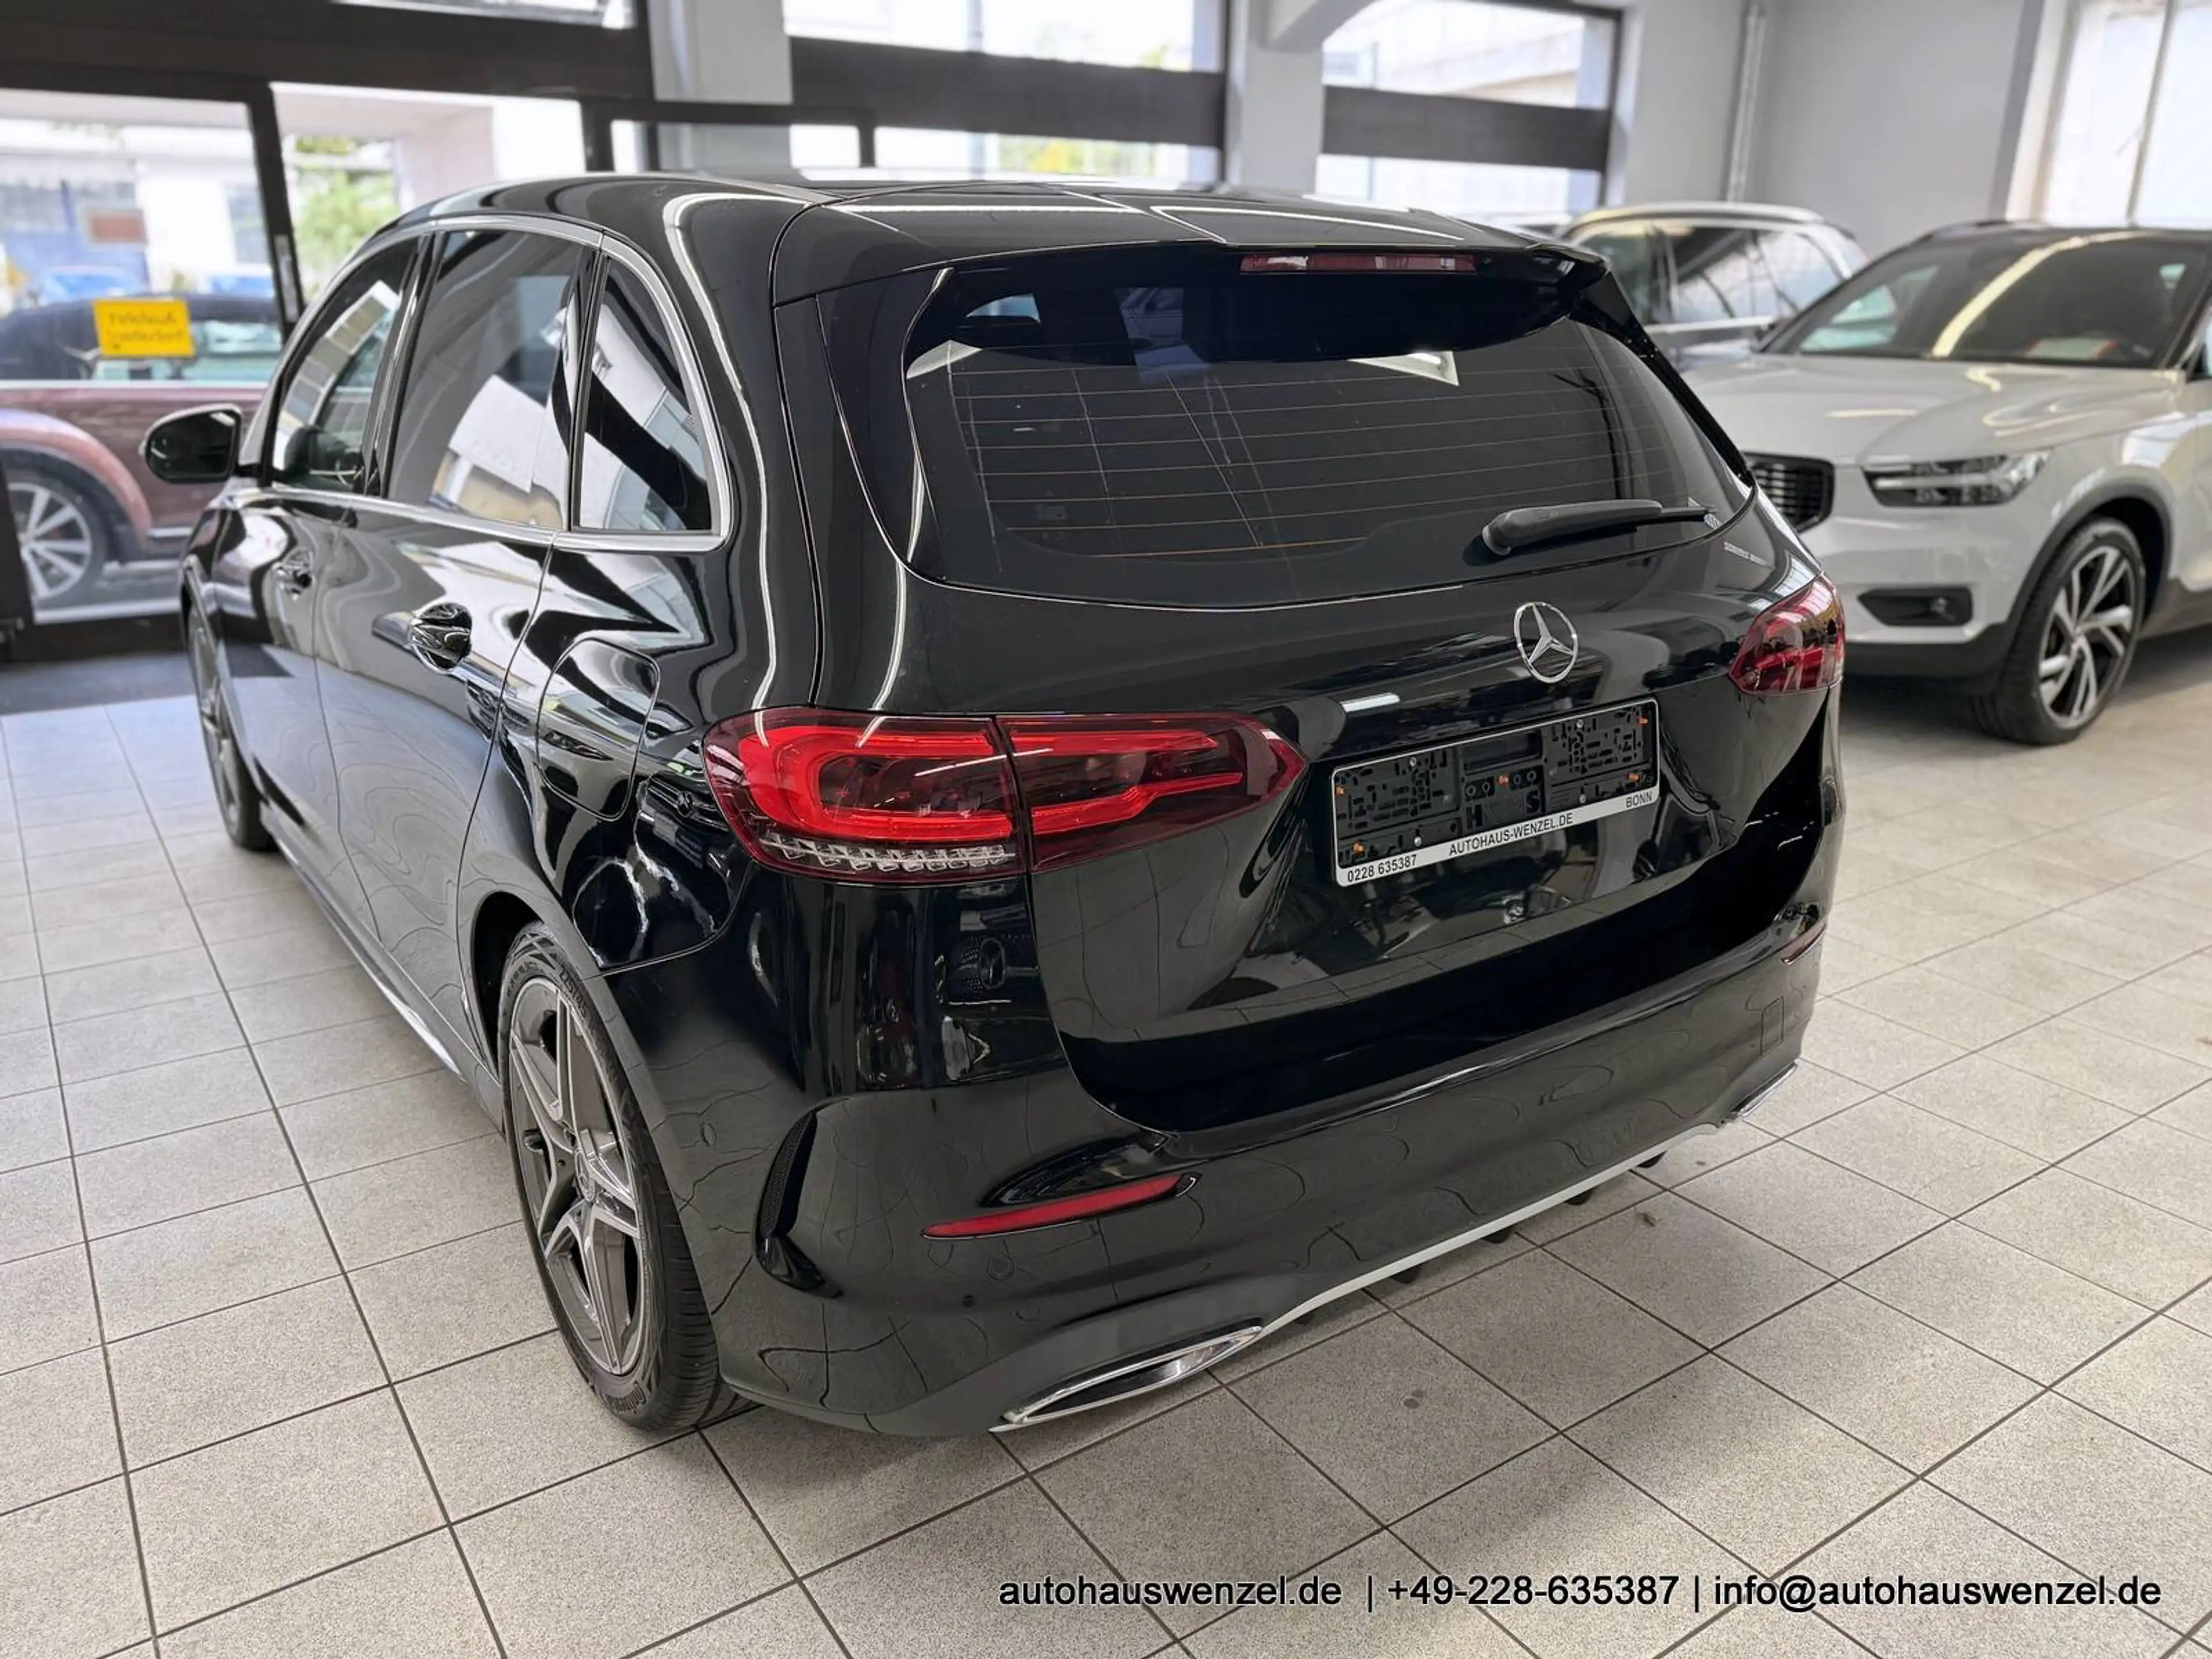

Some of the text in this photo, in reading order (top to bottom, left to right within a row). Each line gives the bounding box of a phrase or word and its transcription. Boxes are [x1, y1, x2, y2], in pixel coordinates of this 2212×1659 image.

[1347, 867, 1374, 882] 0228
[1378, 854, 1417, 875] 635387
[1449, 812, 1574, 856] AUTOHAUS-WENZEL.DE
[1626, 790, 1653, 808] BONN
